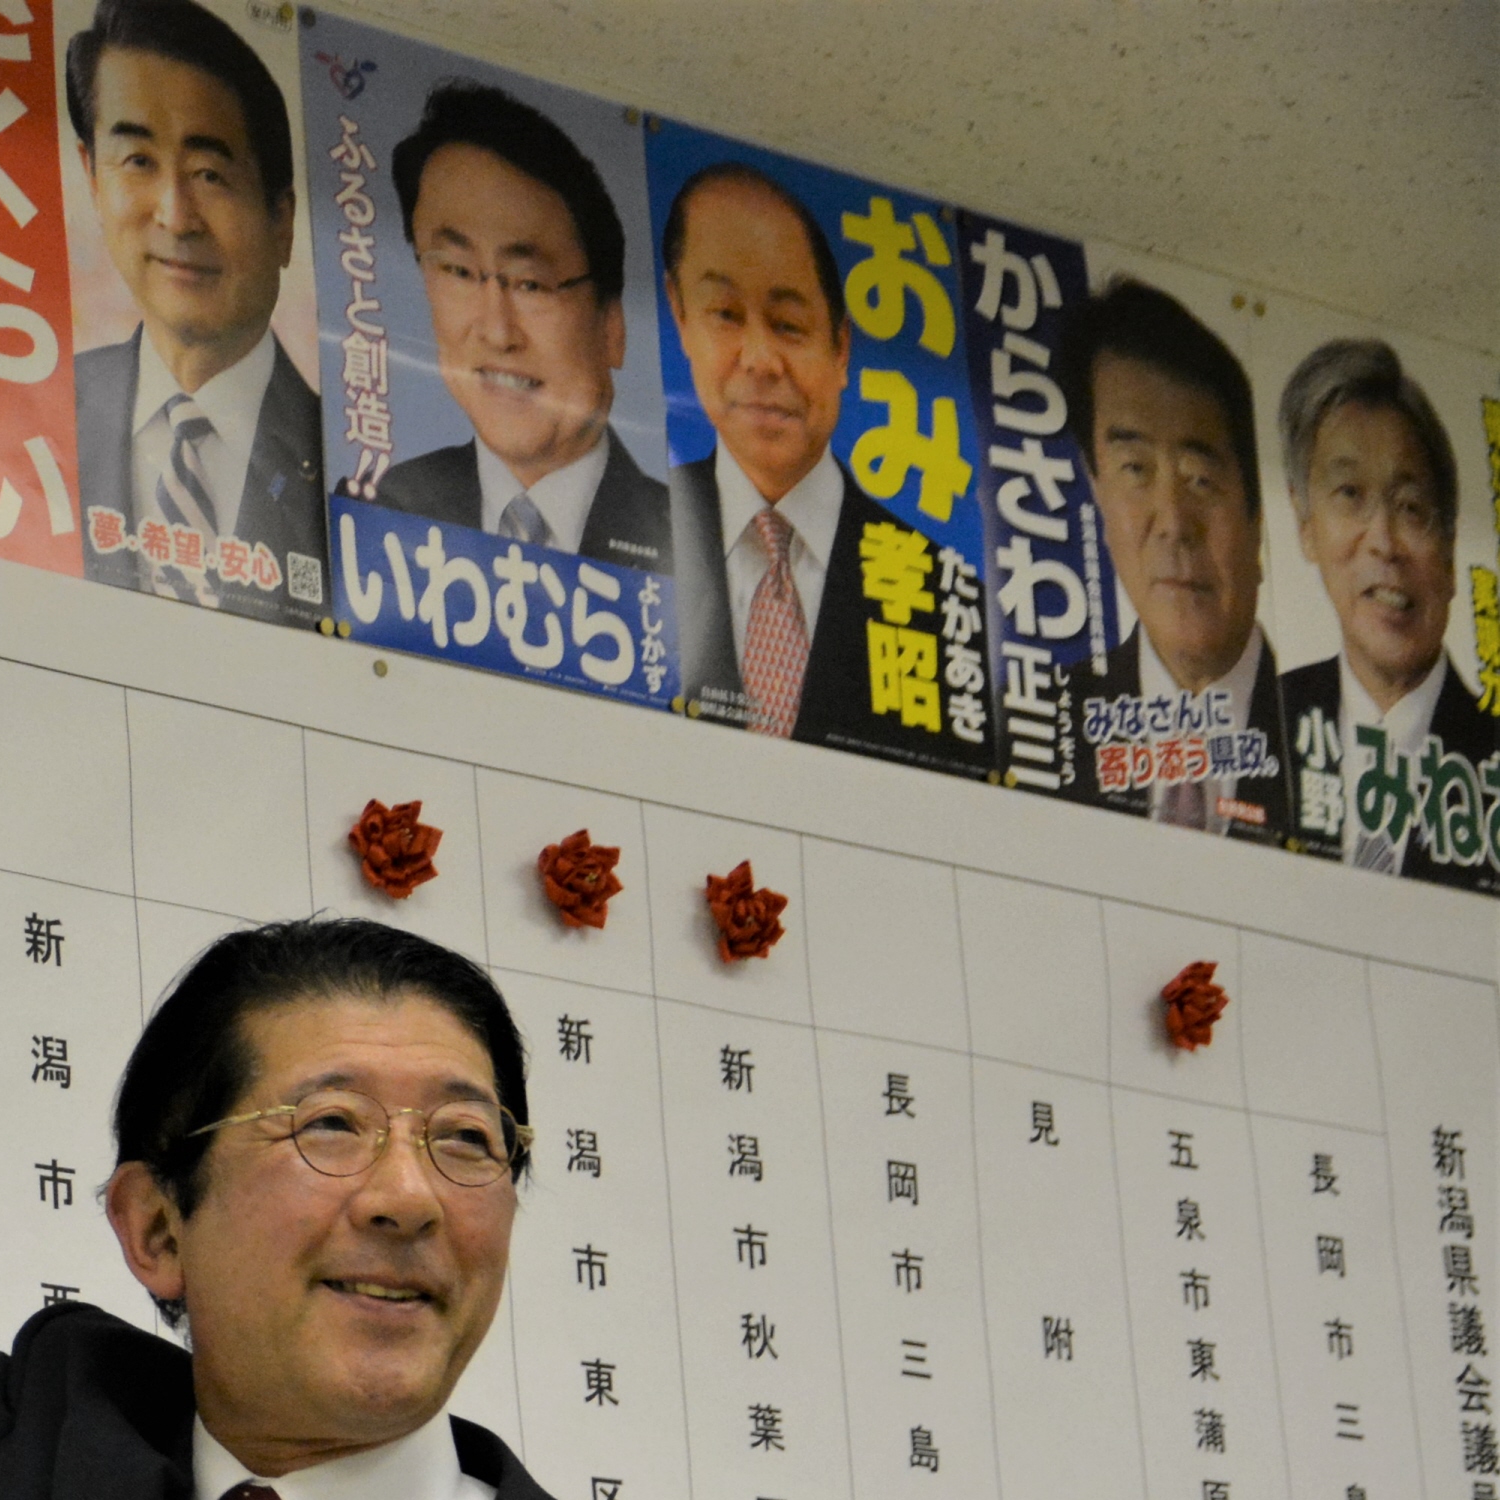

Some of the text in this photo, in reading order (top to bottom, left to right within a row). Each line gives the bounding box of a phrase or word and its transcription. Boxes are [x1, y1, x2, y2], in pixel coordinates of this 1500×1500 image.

[972, 229, 1089, 641] からさわ
[340, 513, 635, 687] いわむら
[939, 547, 987, 743] たかあき
[1084, 690, 1231, 743] みなさんに
[1355, 722, 1500, 872] みね
